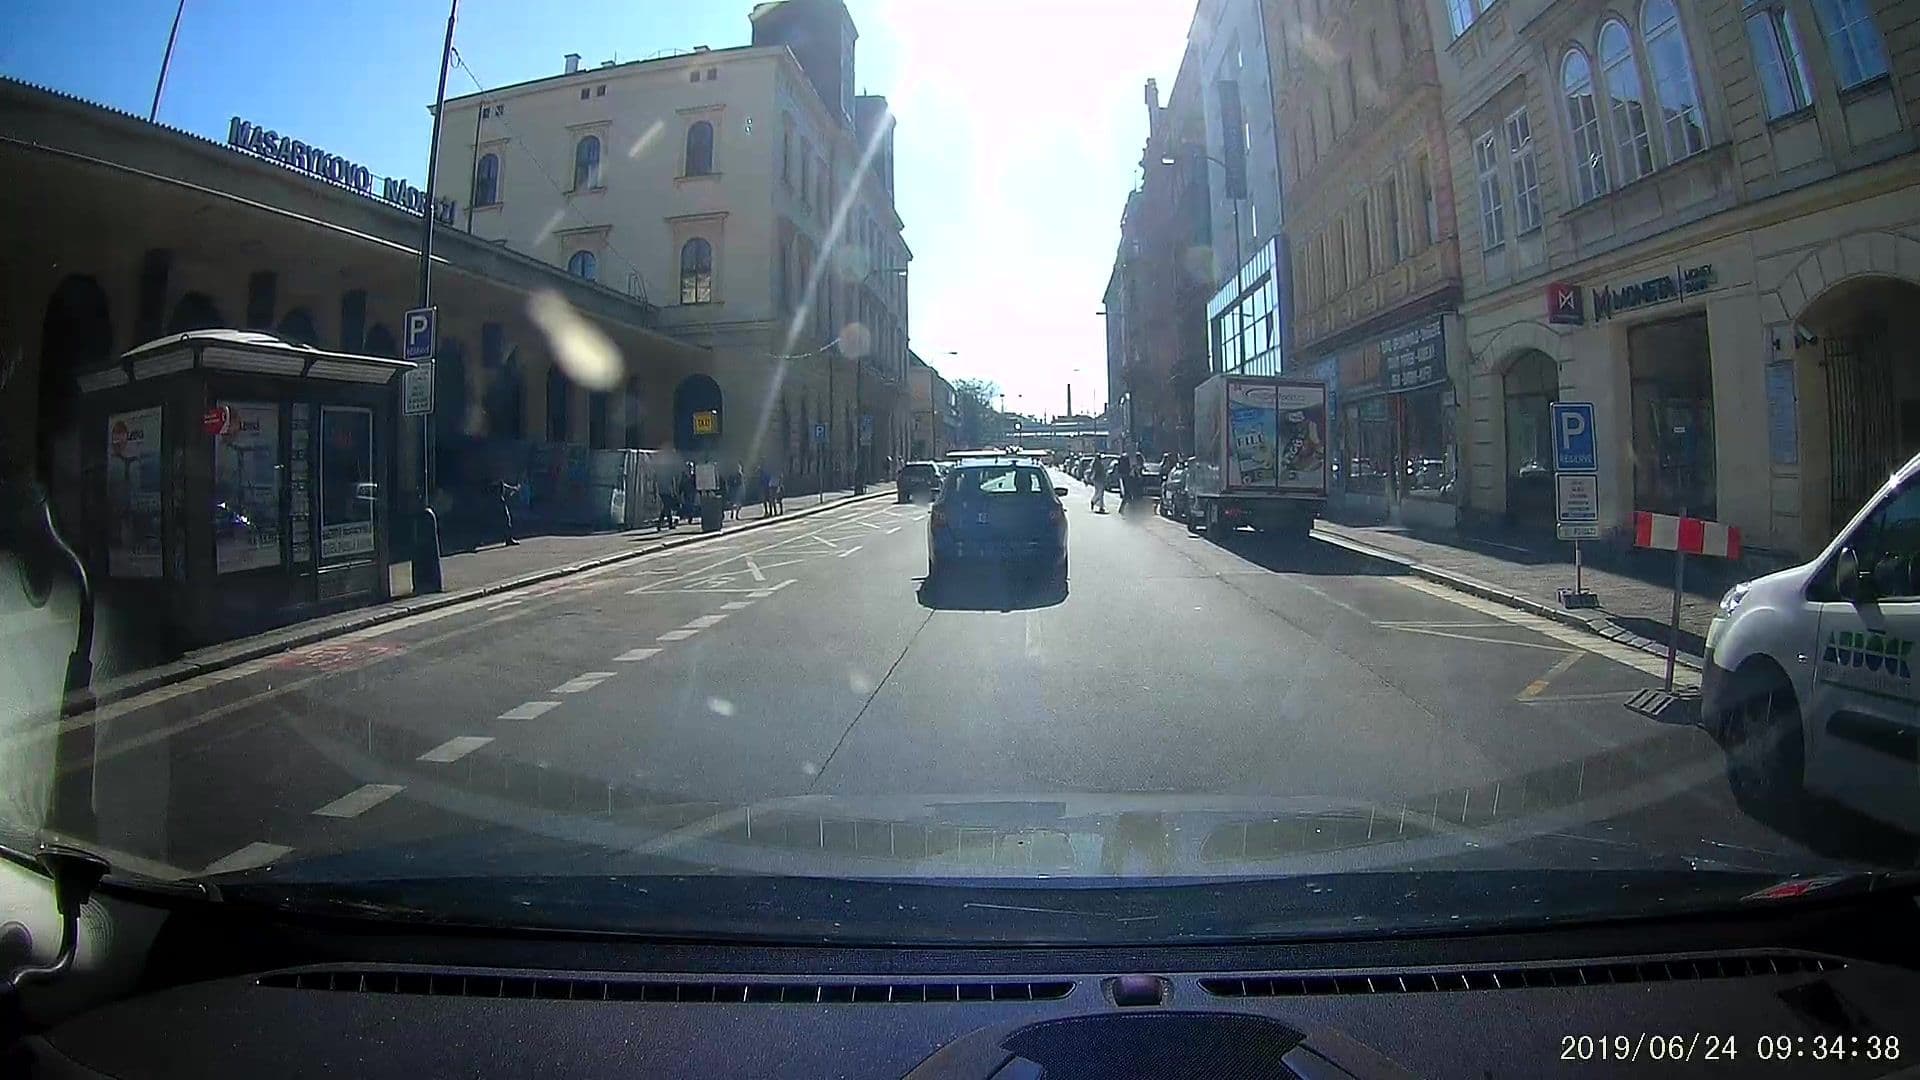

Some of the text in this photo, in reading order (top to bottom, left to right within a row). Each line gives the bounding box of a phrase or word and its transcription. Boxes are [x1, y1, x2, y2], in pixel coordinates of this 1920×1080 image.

[229, 116, 371, 194] MASARYKOVO
[1613, 276, 1677, 309] MONETA
[411, 316, 427, 345] P
[1561, 412, 1585, 448] P
